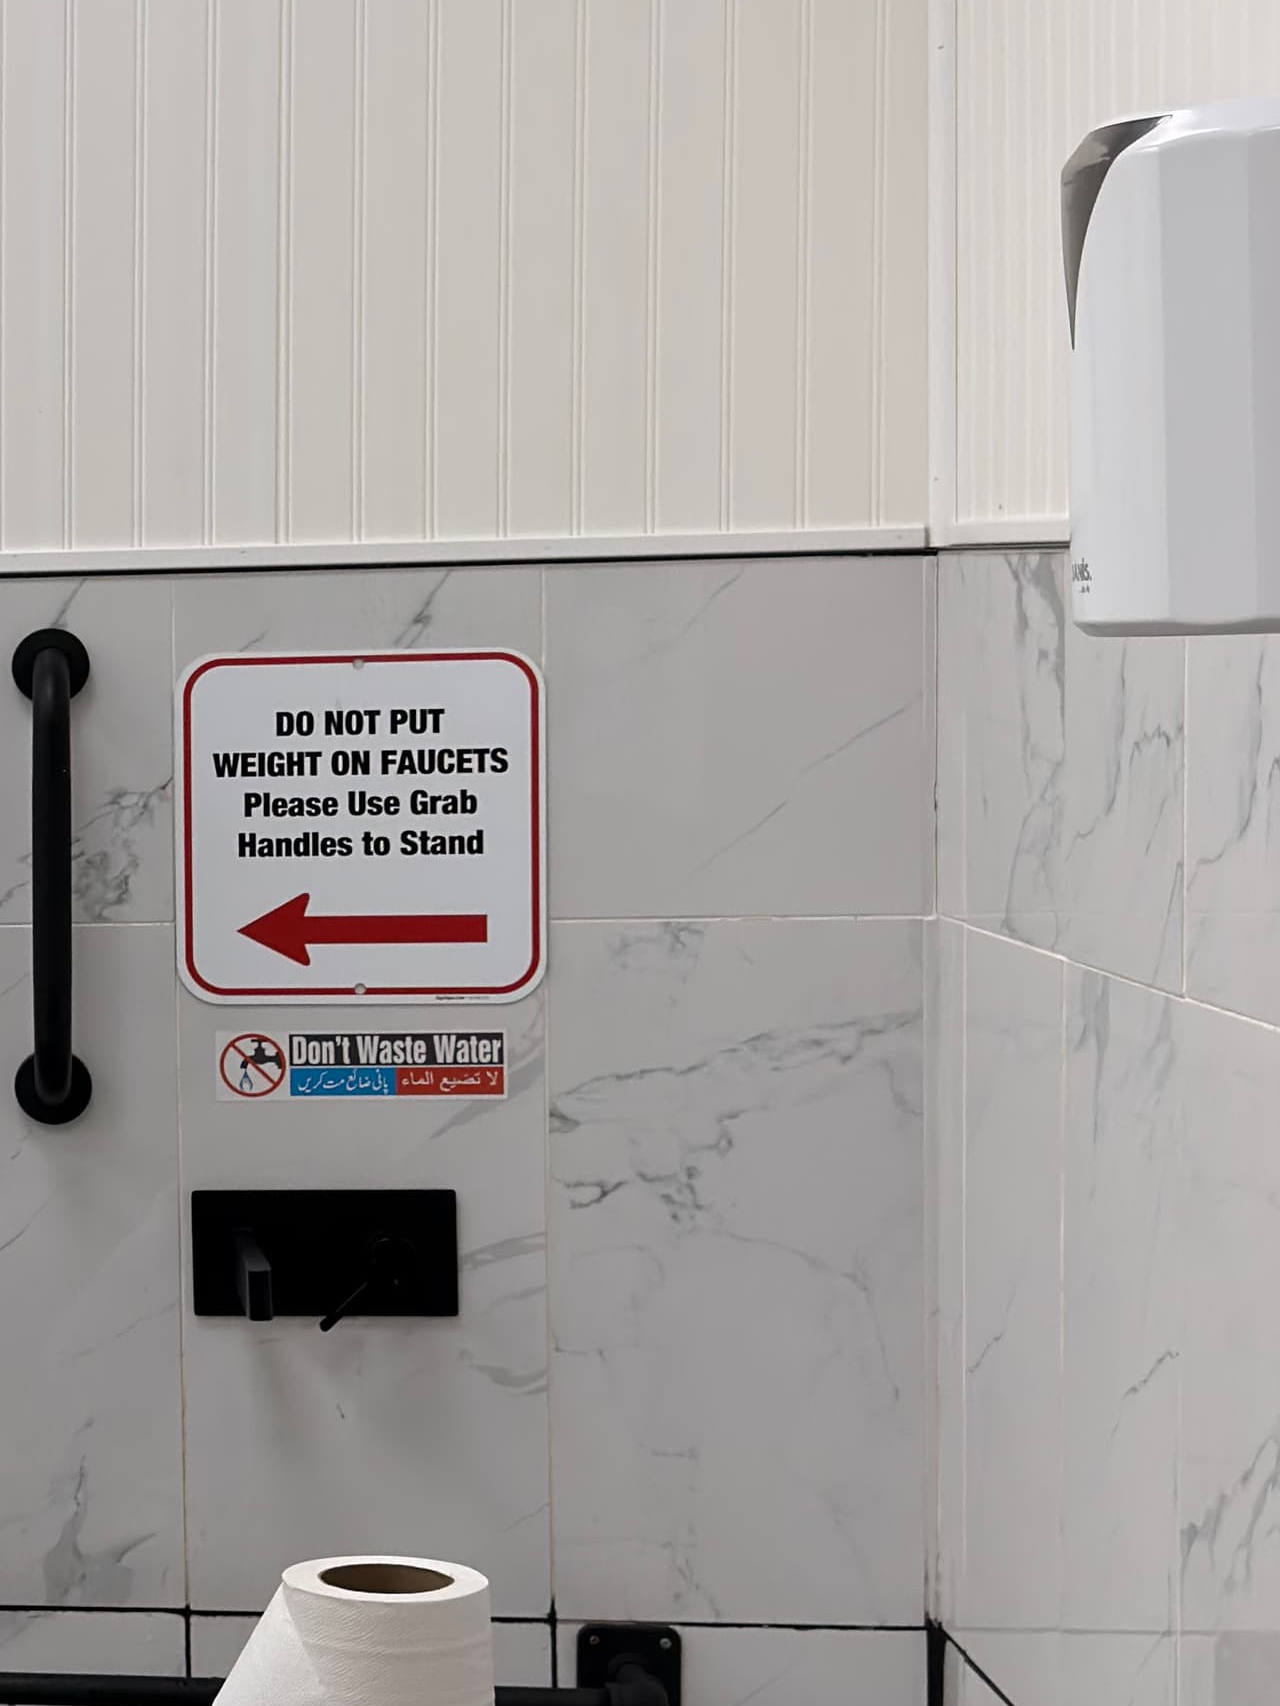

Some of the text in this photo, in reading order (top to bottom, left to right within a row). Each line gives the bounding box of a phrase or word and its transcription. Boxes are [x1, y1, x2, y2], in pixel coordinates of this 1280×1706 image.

[275, 708, 446, 737] DO NOT PUT
[212, 747, 509, 778] WEIGHT ON FAUCETS
[244, 788, 478, 818] Please Use Grab
[238, 829, 484, 858] Handles to Stand
[356, 1035, 426, 1064] Waste
[433, 1035, 500, 1063] Water
